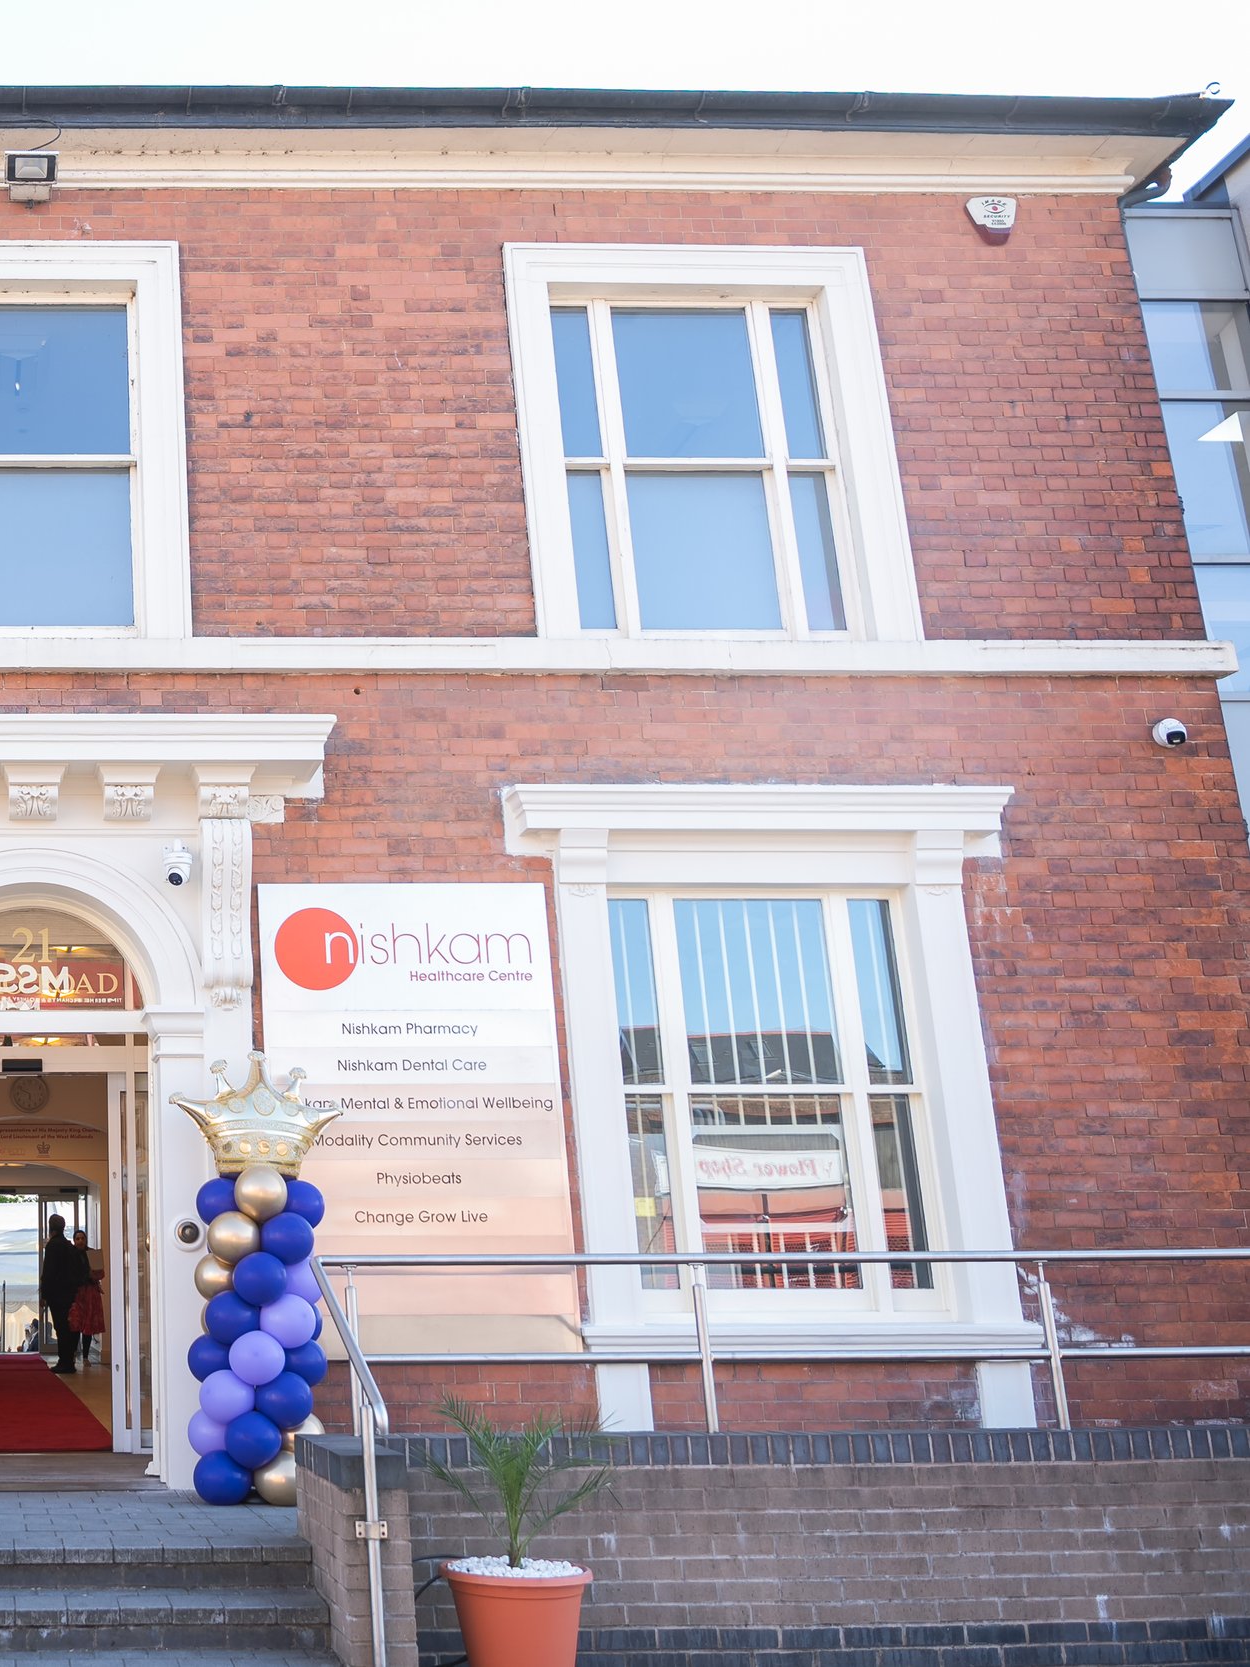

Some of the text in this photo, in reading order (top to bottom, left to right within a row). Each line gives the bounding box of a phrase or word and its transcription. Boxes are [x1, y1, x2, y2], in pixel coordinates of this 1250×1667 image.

[11, 927, 53, 963] 21
[324, 923, 533, 965] nishkam
[410, 971, 533, 982] Healthcare Centre
[341, 1023, 478, 1038] Nishkam Pharmacy
[337, 1059, 487, 1072] Nishkam Dental Care
[341, 1097, 390, 1110] Mental
[394, 1098, 404, 1109] &
[408, 1097, 479, 1110] Emotional
[482, 1097, 553, 1112] Wellbeing
[312, 1133, 522, 1149] Modality Community Services
[376, 1172, 462, 1187] Physiobeats
[354, 1210, 488, 1226] Change Grow Live
